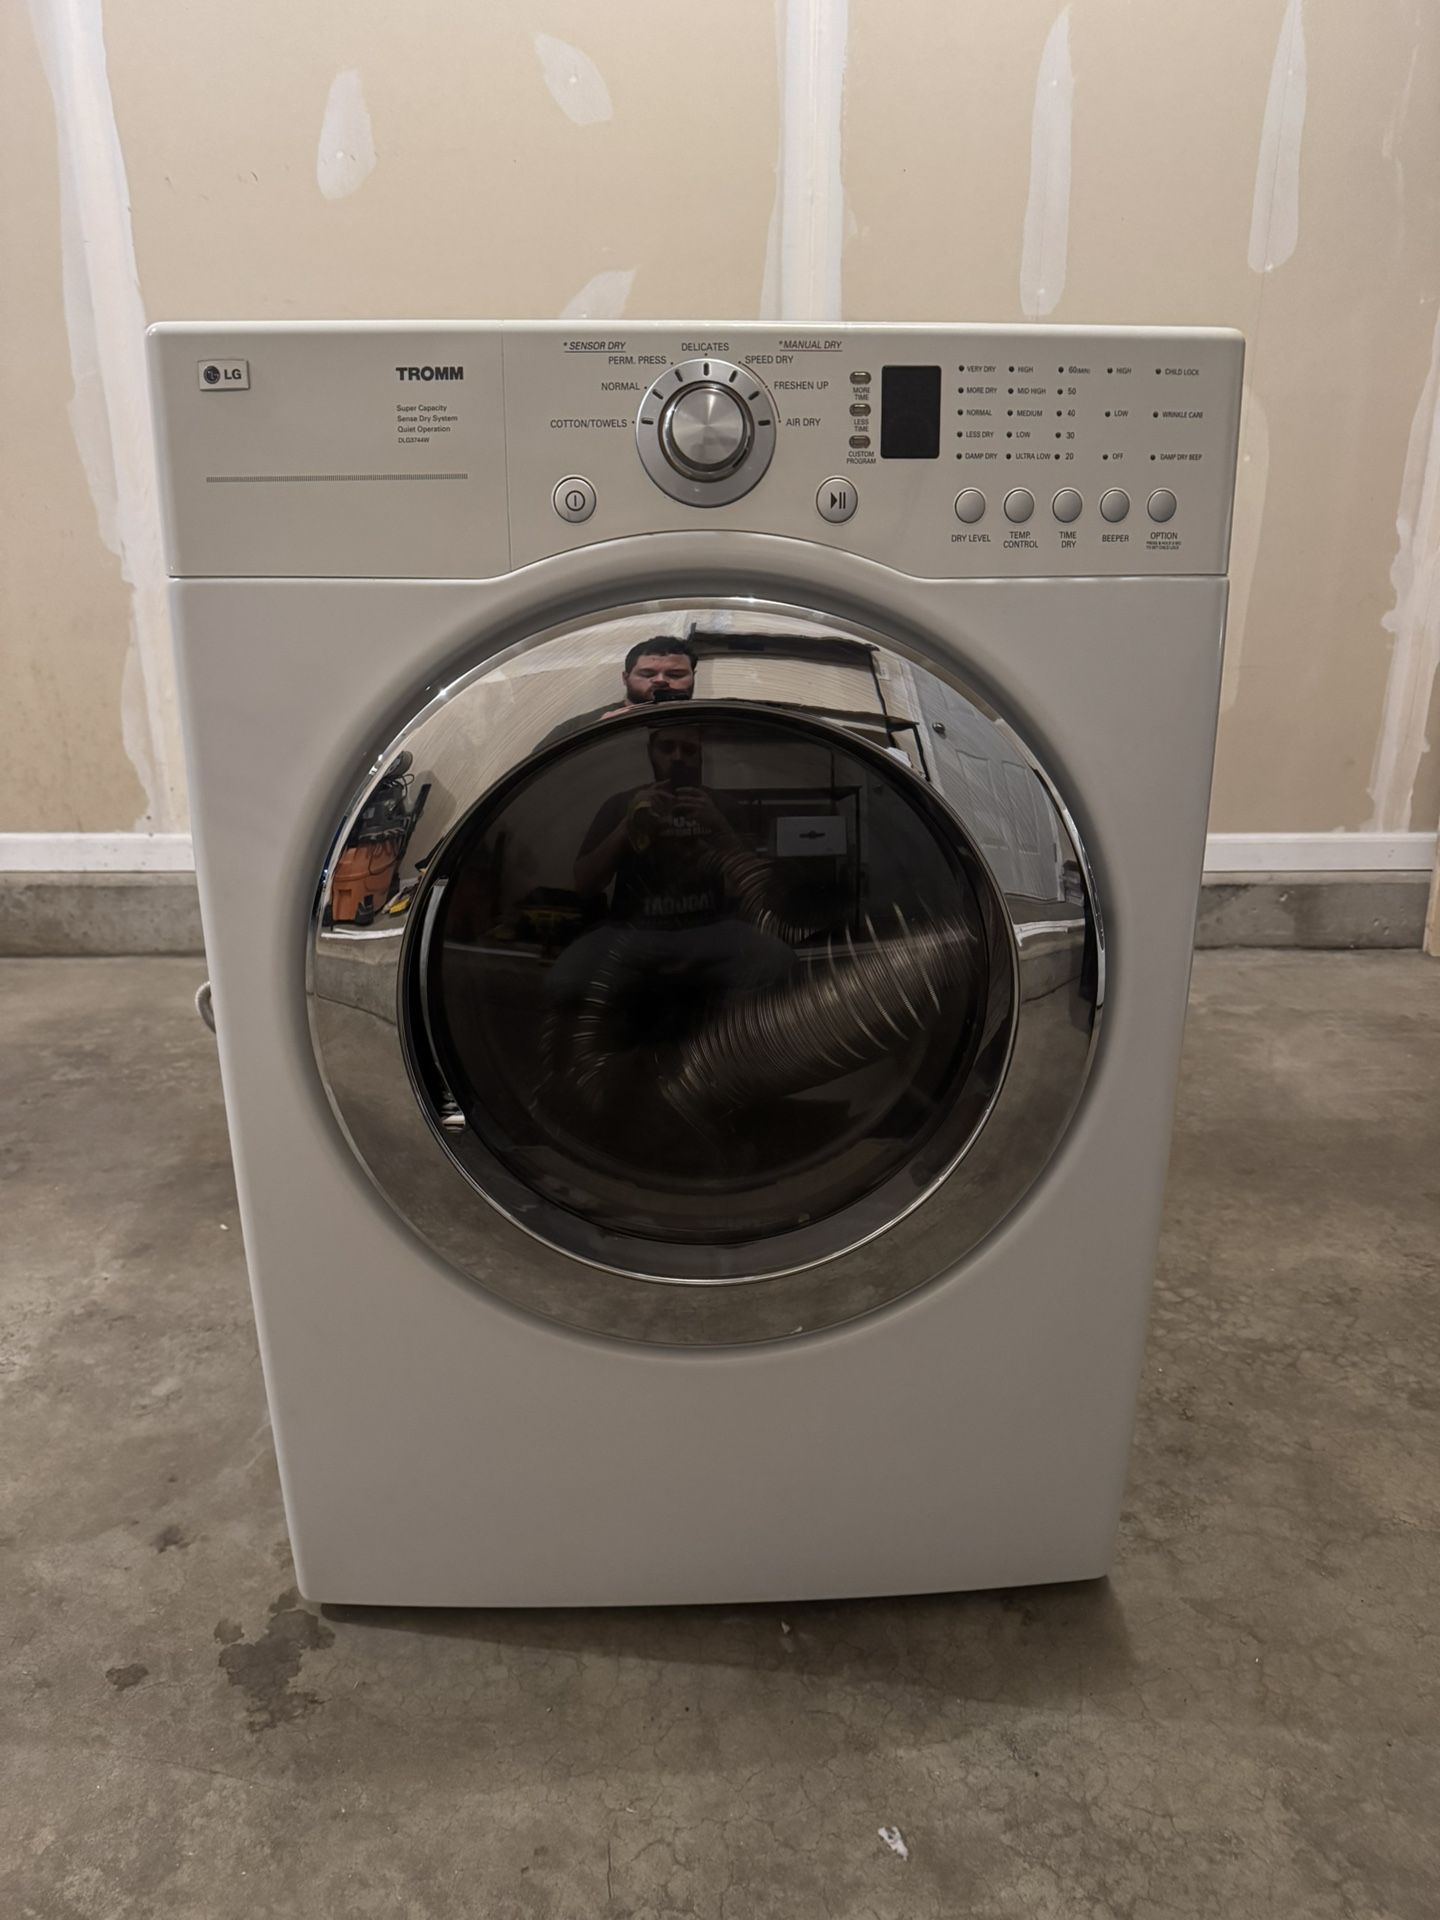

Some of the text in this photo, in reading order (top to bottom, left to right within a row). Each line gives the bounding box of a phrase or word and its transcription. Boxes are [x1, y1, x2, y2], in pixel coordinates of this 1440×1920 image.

[569, 342, 626, 350] SENSOR DRY
[681, 342, 729, 351] DELICATES
[824, 341, 842, 349] DRY
[608, 356, 667, 365] PERM. PRESS
[744, 355, 793, 364] SPEED DRY
[224, 368, 242, 380] LG
[396, 366, 464, 381] TROMM
[601, 382, 640, 391] NORMAL
[774, 381, 829, 390] FRESHEN UP
[396, 404, 447, 413] Super Capacity
[397, 414, 458, 424] Sense Dry System
[550, 419, 627, 428] COTTON/TOWELS
[786, 418, 821, 426] AIR DRY
[397, 425, 451, 434] Quiet Operation
[951, 534, 991, 543] DRY LEVEL
[1059, 531, 1077, 539] TIME
[1102, 534, 1129, 543] BEEPER
[1150, 531, 1177, 540] OPTION
[1003, 540, 1038, 549] CONTROL
[1061, 540, 1076, 549] DRY
